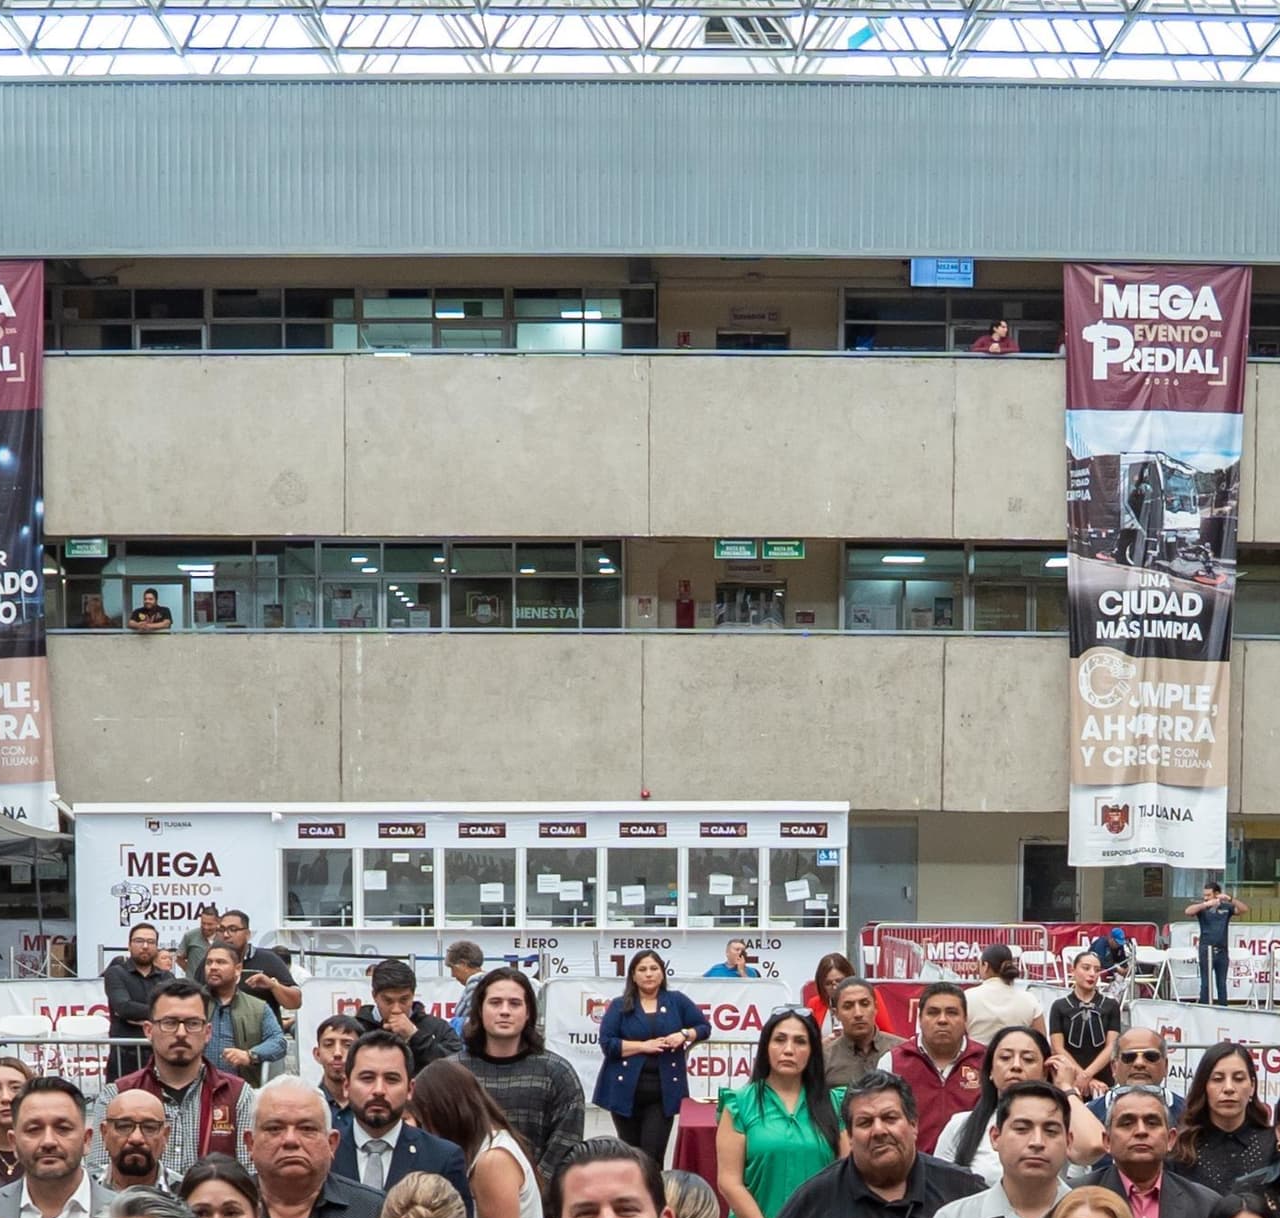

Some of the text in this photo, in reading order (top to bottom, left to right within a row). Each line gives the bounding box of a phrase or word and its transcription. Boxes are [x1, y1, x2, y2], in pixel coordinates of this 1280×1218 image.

[1102, 284, 1222, 321] MEGA
[1134, 324, 1208, 343] EVENTO
[1082, 320, 1220, 380] PREDIAL
[1139, 574, 1170, 588] UNA
[1099, 590, 1203, 617] CIUDAD
[1096, 617, 1203, 641] MÁS LIMPIA
[1, 746, 25, 756] CON
[1081, 745, 1171, 767] Y CRECE
[1174, 748, 1199, 758] CON
[1173, 758, 1213, 769] TIJUANA
[1138, 804, 1194, 821] TIJUANA
[309, 826, 344, 836] CAJA 1
[389, 826, 424, 836] CAJA 2
[469, 827, 494, 835] CAJA
[549, 827, 575, 835] CAJA
[631, 826, 665, 836] CAJA 5
[711, 826, 746, 836] CAJA 6
[791, 826, 825, 836] CAJA 7
[128, 852, 221, 877] MEGA
[152, 883, 211, 896] EVENTO
[613, 938, 671, 949] FEBRERO
[927, 942, 982, 960] MEGA
